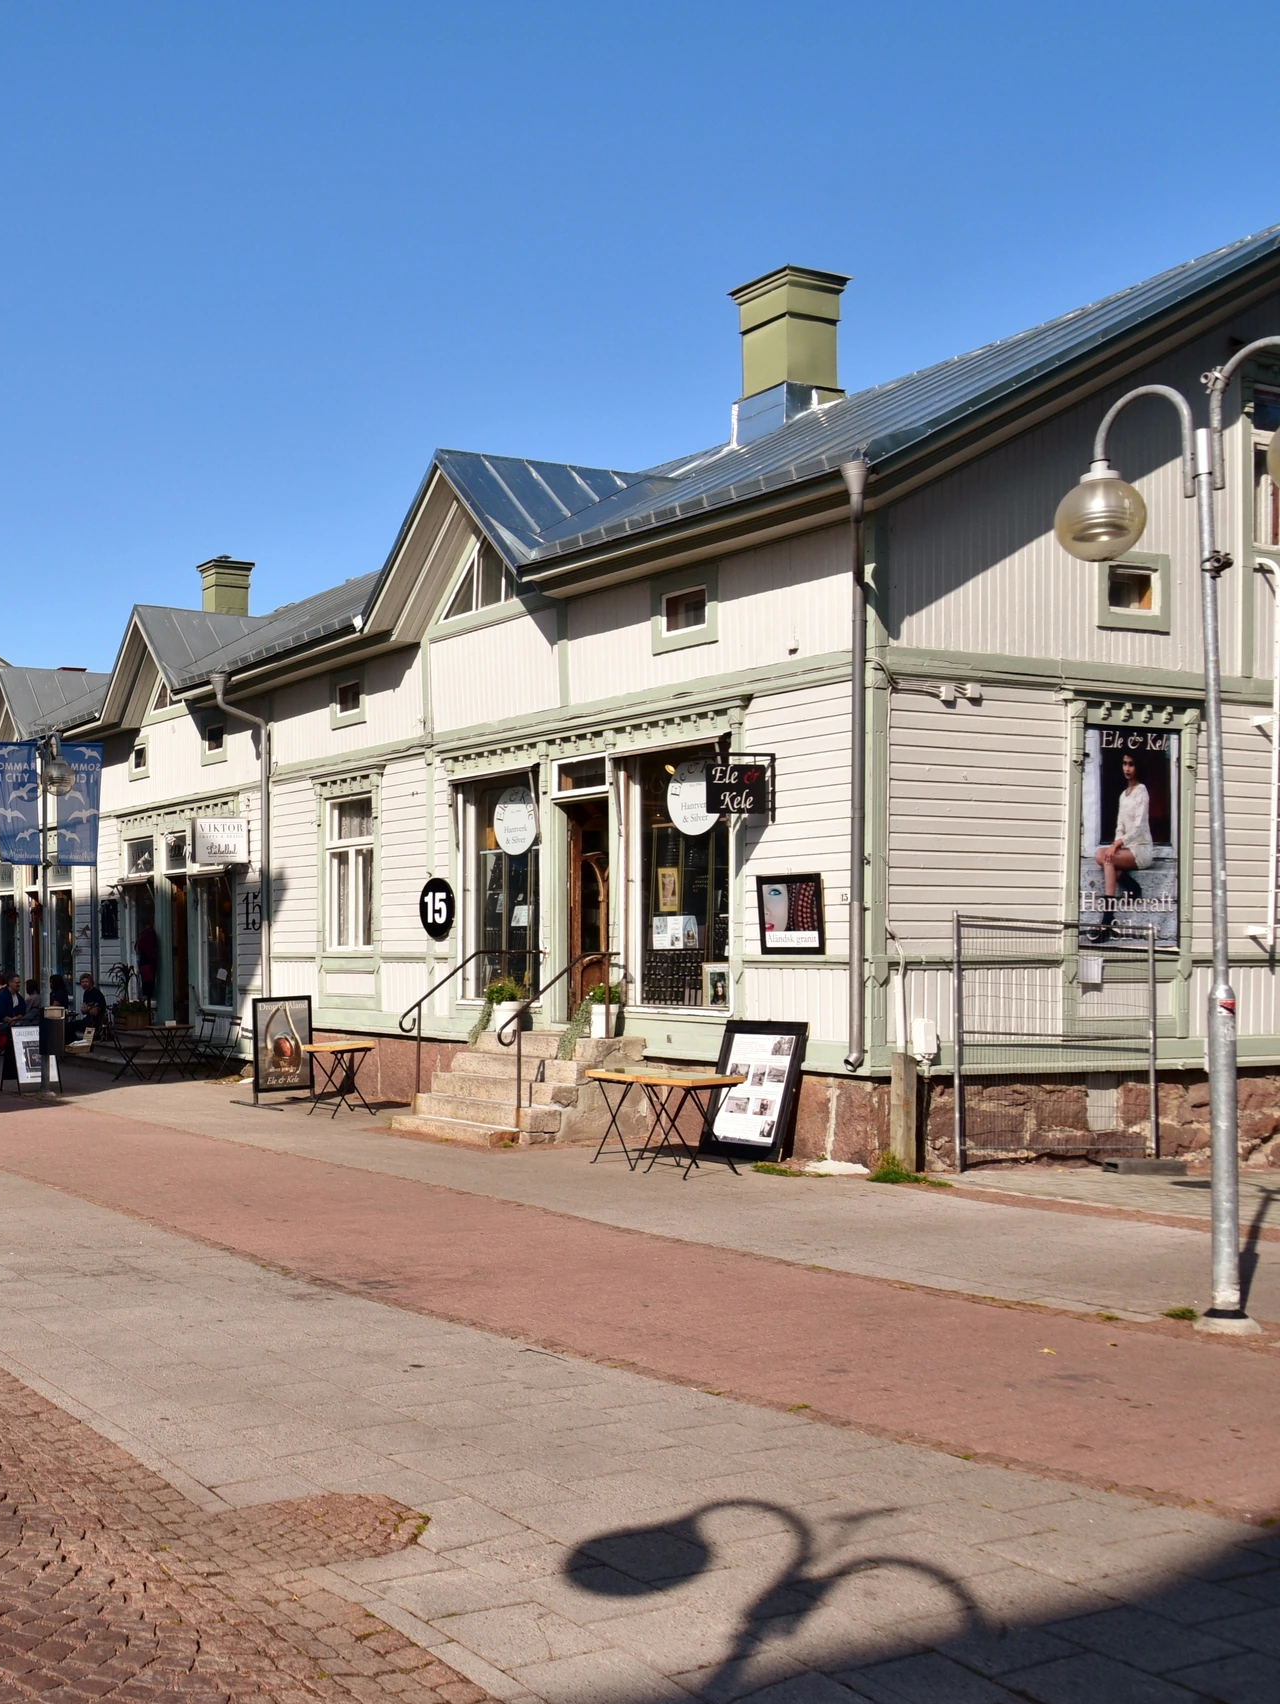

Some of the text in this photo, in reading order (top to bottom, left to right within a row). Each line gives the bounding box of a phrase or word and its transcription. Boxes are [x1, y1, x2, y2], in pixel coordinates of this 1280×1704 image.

[1101, 730, 1172, 751] Ele & Kele
[0, 774, 29, 783] I CITY
[712, 765, 739, 784] Ele
[743, 769, 760, 784] &
[681, 802, 706, 811] Hantver
[720, 789, 754, 812] Kele
[200, 824, 243, 832] VIKTOR
[841, 893, 848, 902] 15
[1080, 891, 1175, 912] Handicraft
[242, 888, 262, 931] 15
[424, 891, 447, 924] 15
[287, 1075, 300, 1083] Kele
